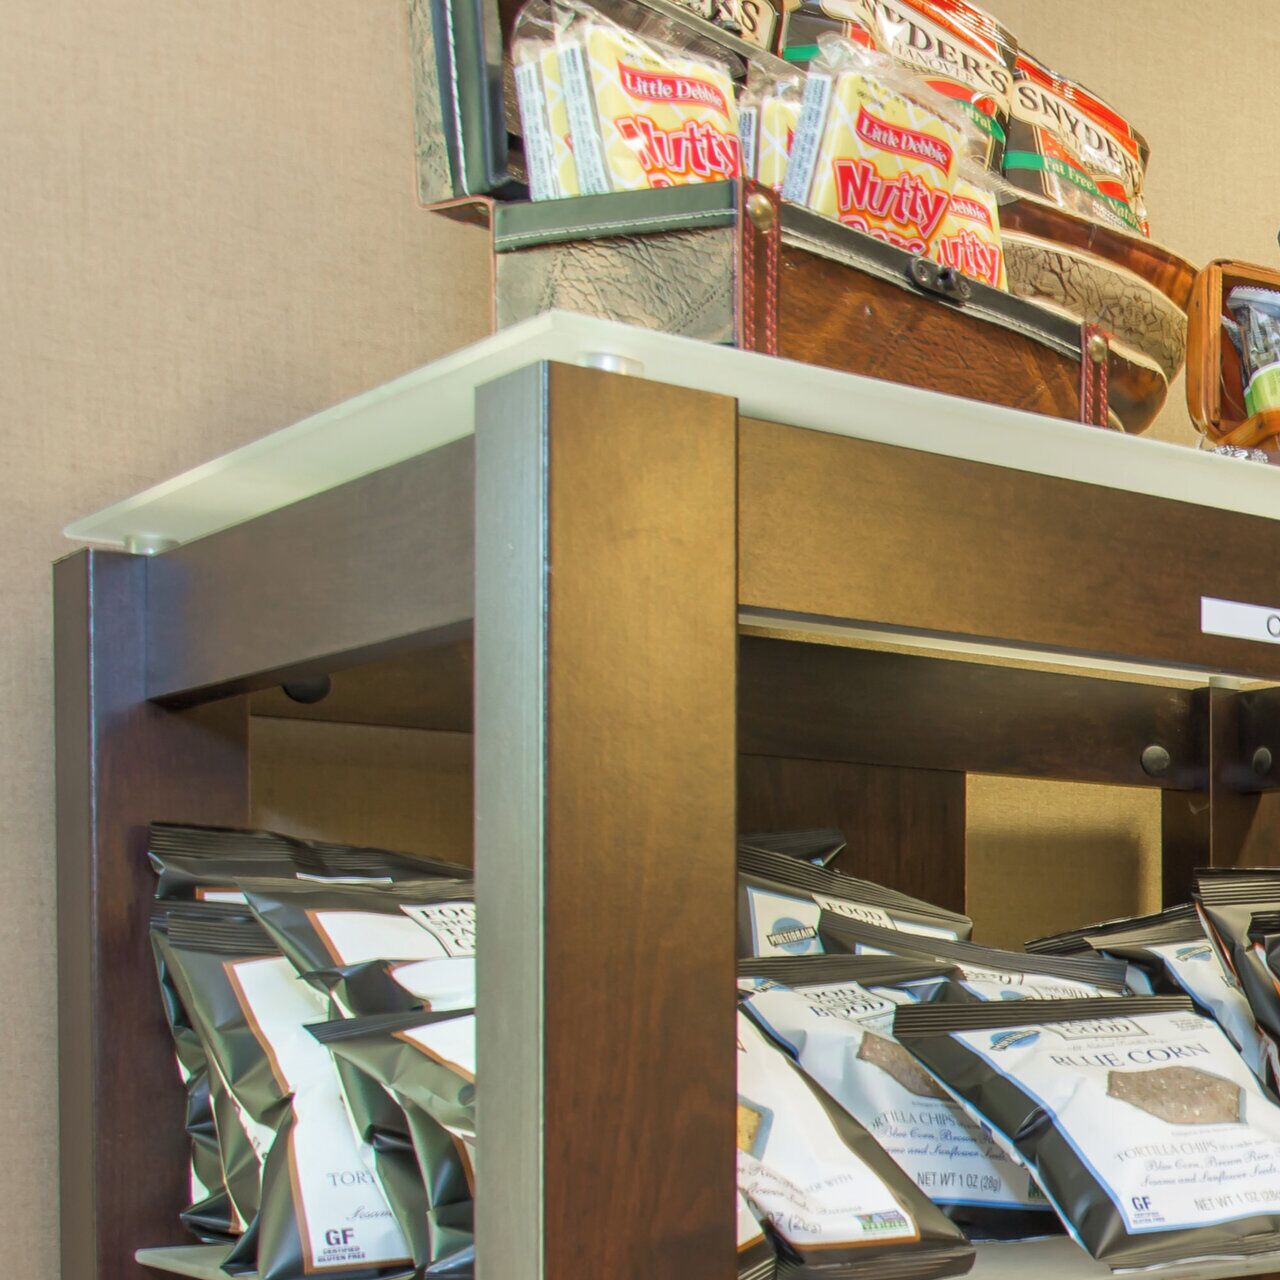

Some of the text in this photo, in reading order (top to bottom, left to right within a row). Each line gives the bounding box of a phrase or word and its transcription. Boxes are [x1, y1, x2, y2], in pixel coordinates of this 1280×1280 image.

[624, 71, 674, 98] Little
[617, 115, 742, 176] Nutty
[859, 120, 948, 167] Little Debbie
[832, 158, 951, 240] Nutty
[1050, 1042, 1211, 1068] BLUE CORN
[919, 1111, 956, 1129] CHIPS
[1114, 1138, 1219, 1163] TORTILLA CHIPS
[916, 1171, 938, 1186] NET
[939, 1171, 958, 1187] WT
[965, 1173, 979, 1188] OZ
[1198, 1170, 1248, 1187] Sunflower
[1131, 1195, 1152, 1211] GF
[1193, 1197, 1217, 1212] NET
[1217, 1195, 1234, 1209] WT
[1245, 1192, 1259, 1203] OZ
[325, 1228, 356, 1247] GF
